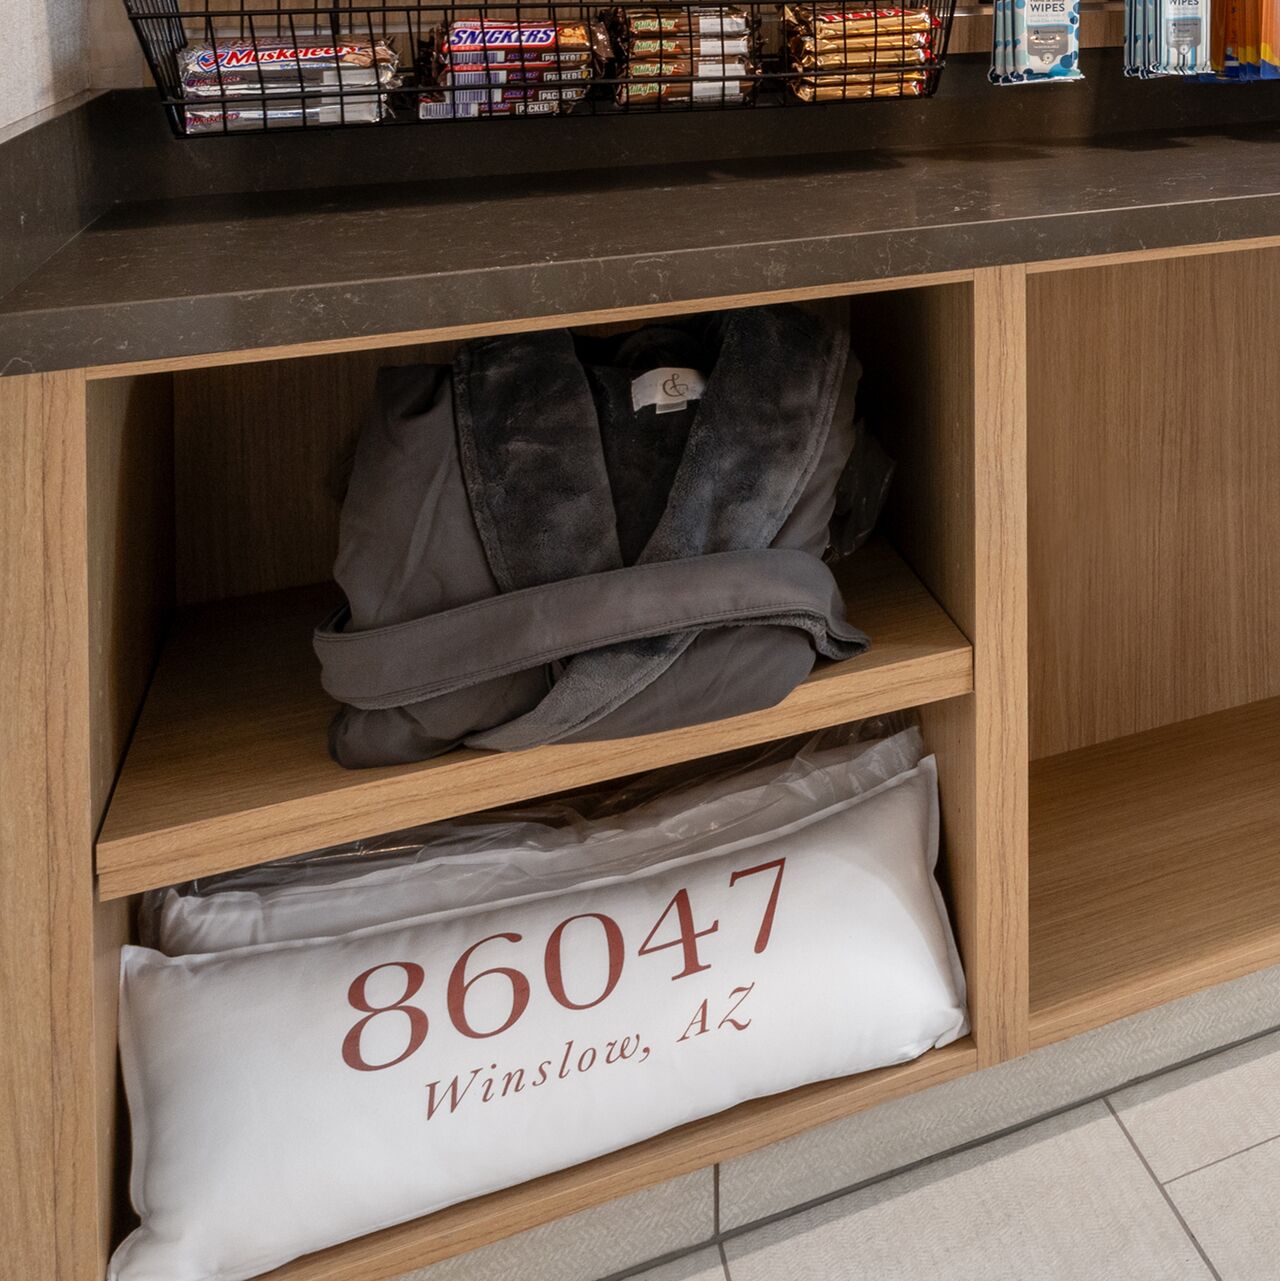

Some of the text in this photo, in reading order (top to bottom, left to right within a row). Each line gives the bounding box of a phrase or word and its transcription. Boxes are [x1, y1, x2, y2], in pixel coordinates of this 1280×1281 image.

[1030, 3, 1065, 12] WIPES
[450, 29, 555, 46] SNICKERS
[225, 46, 359, 66] Musketeers
[518, 104, 550, 113] PCKED
[341, 856, 788, 1073] 86047
[423, 982, 758, 1124] Winslow, AZ
